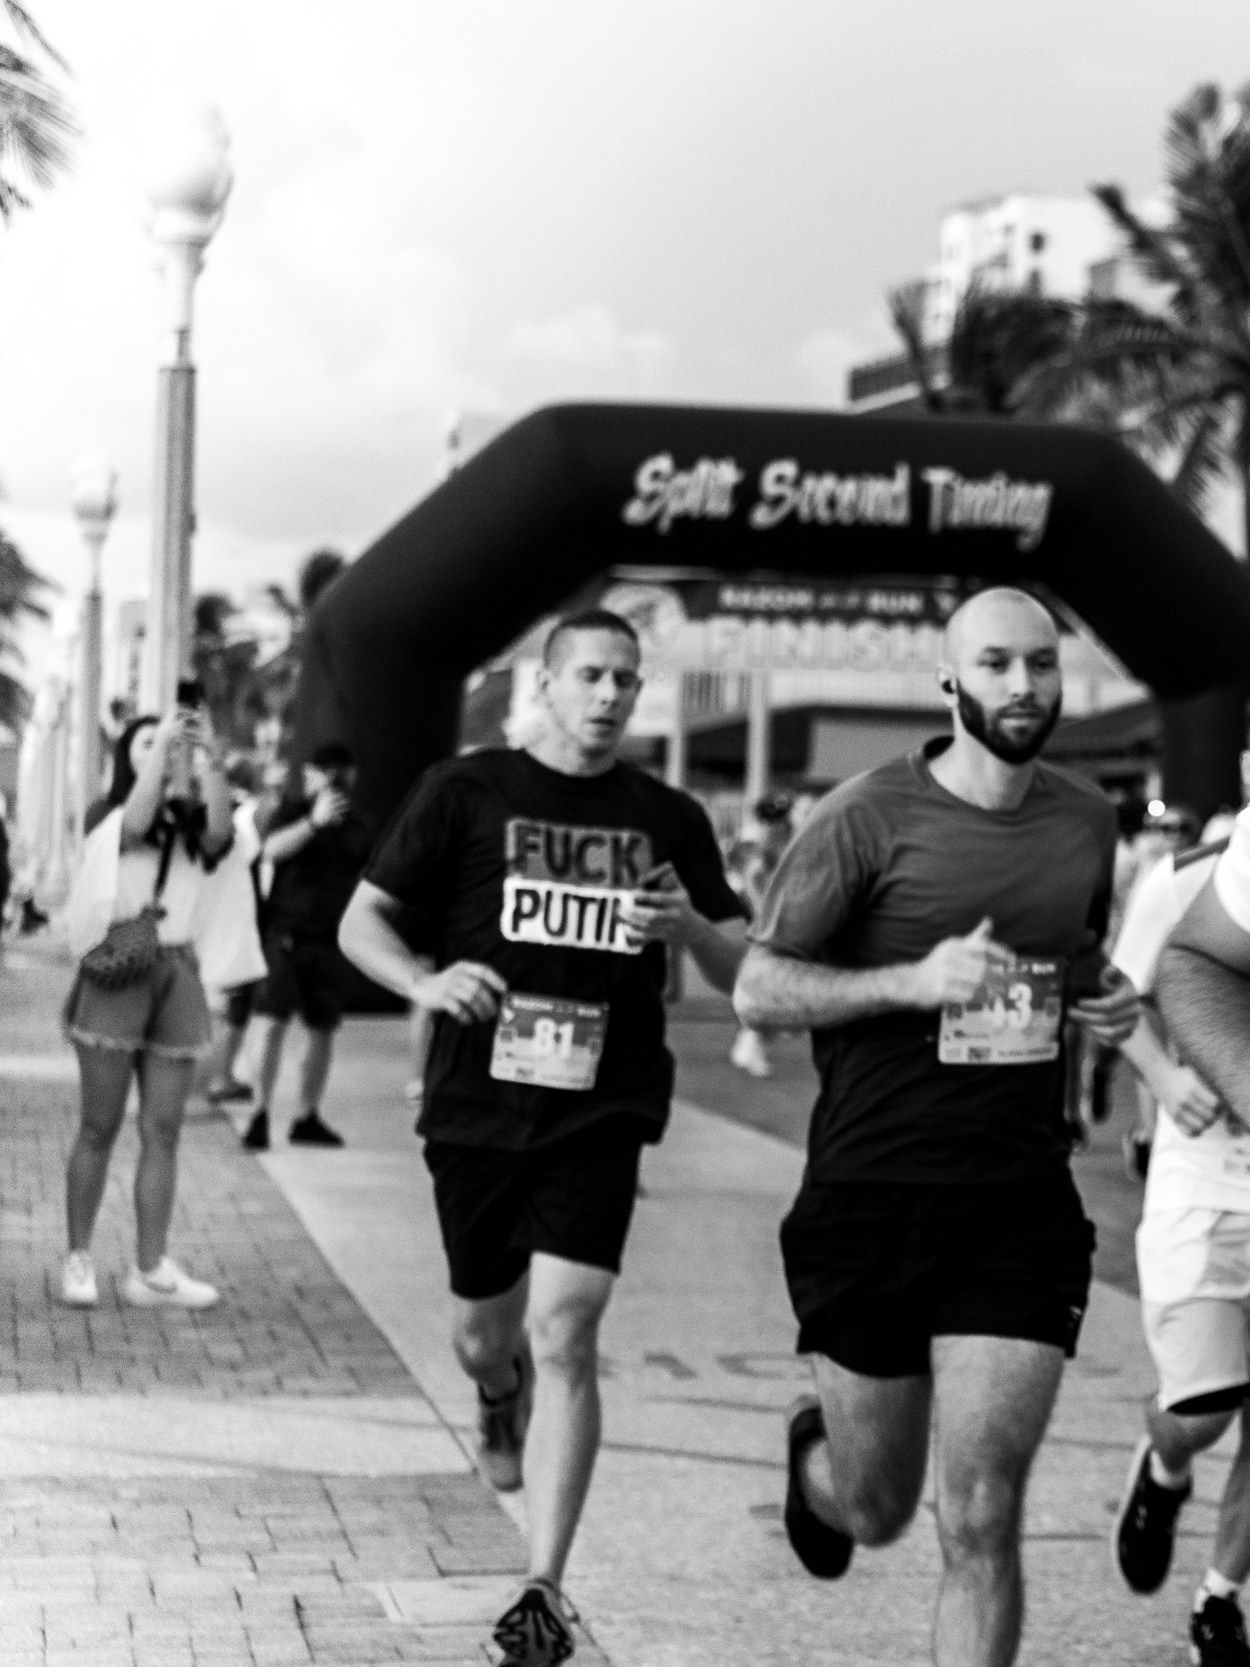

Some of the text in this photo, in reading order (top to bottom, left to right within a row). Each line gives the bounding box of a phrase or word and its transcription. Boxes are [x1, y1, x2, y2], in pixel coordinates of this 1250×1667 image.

[622, 452, 1054, 552] Split Second Timing
[514, 824, 643, 889] FUCK
[534, 1017, 575, 1059] 81
